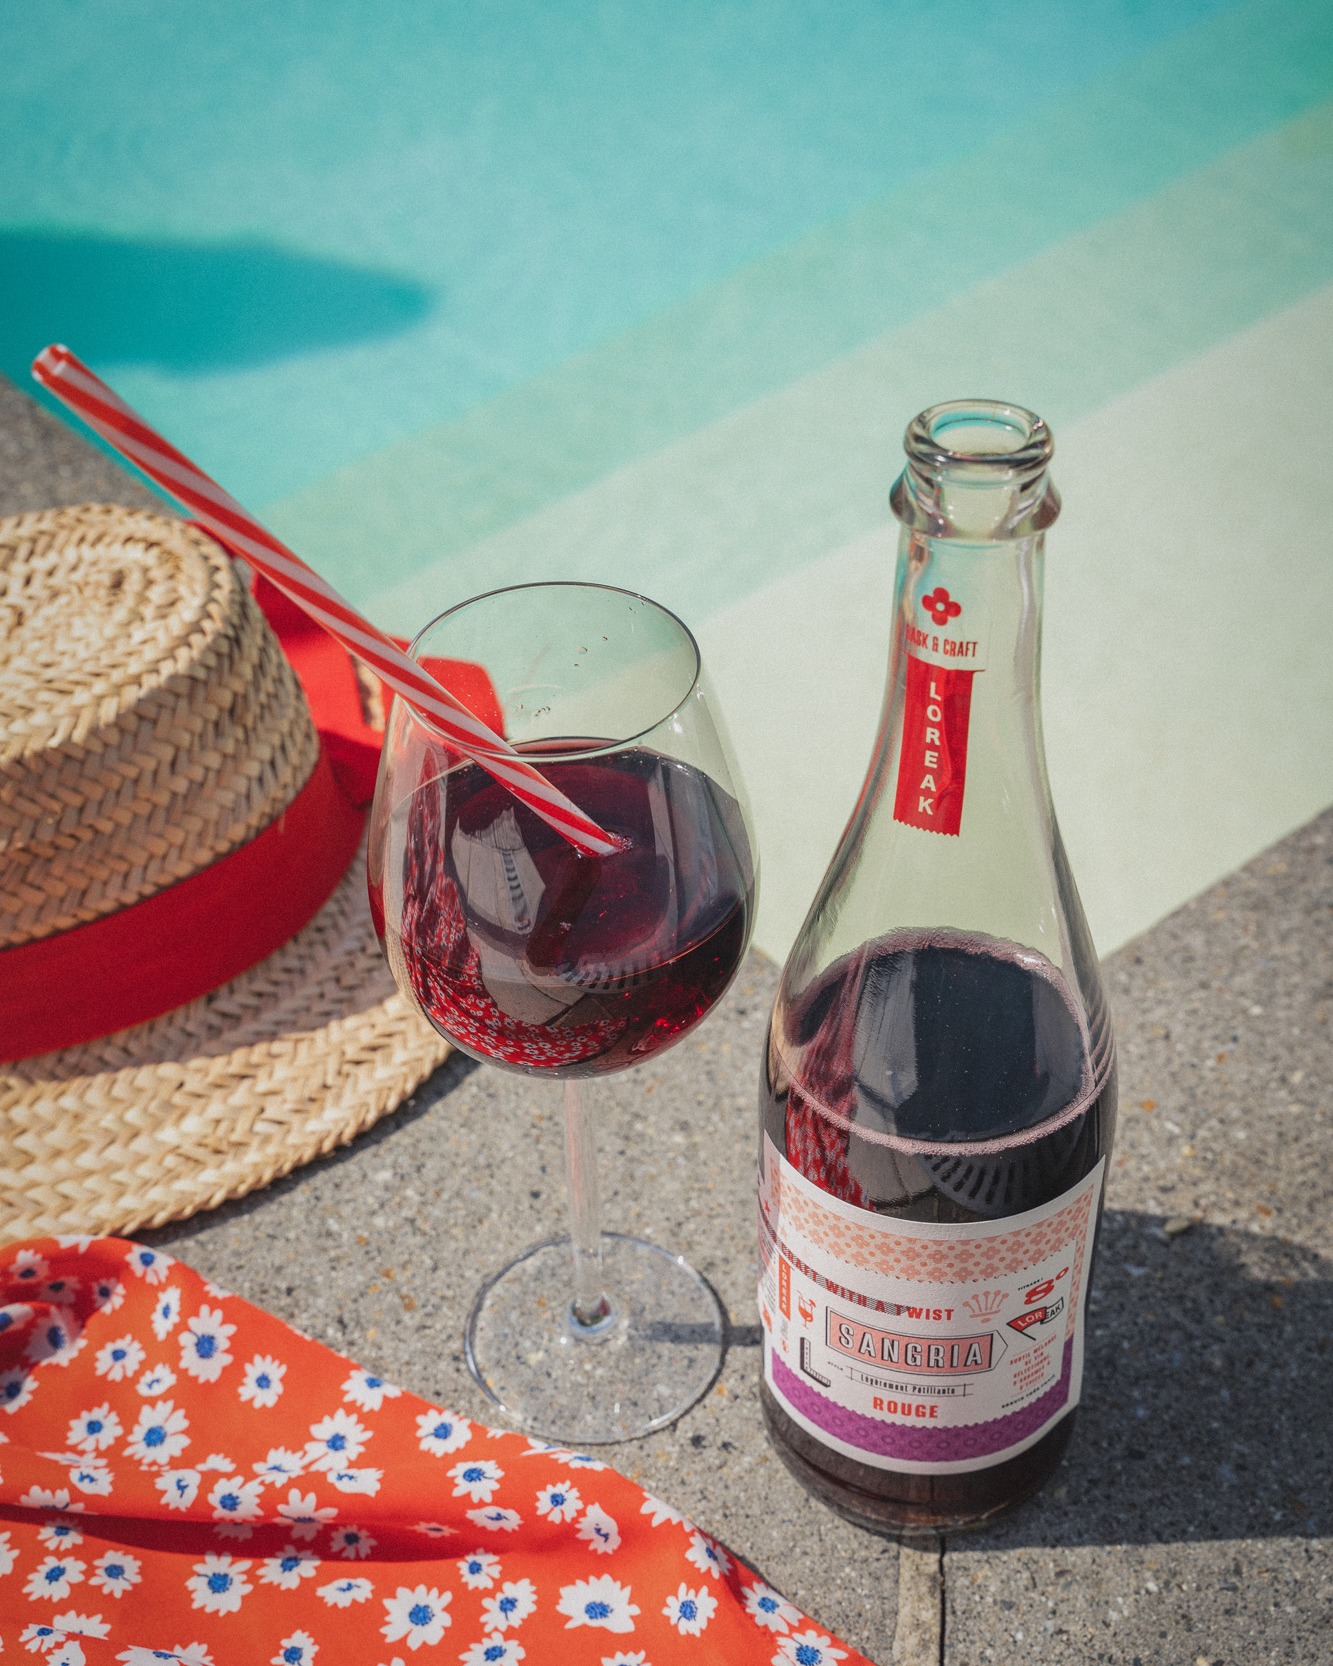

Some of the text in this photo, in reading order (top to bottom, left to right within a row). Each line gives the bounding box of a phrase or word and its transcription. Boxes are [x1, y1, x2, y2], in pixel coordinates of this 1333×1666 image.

[931, 635, 939, 654] &
[943, 638, 979, 658] CRAFT
[917, 681, 942, 815] LOREAK
[825, 1277, 868, 1307] WITH
[895, 1303, 955, 1321] TWIST
[838, 1322, 984, 1369] SANGRIA
[873, 1396, 939, 1419] ROUGE
